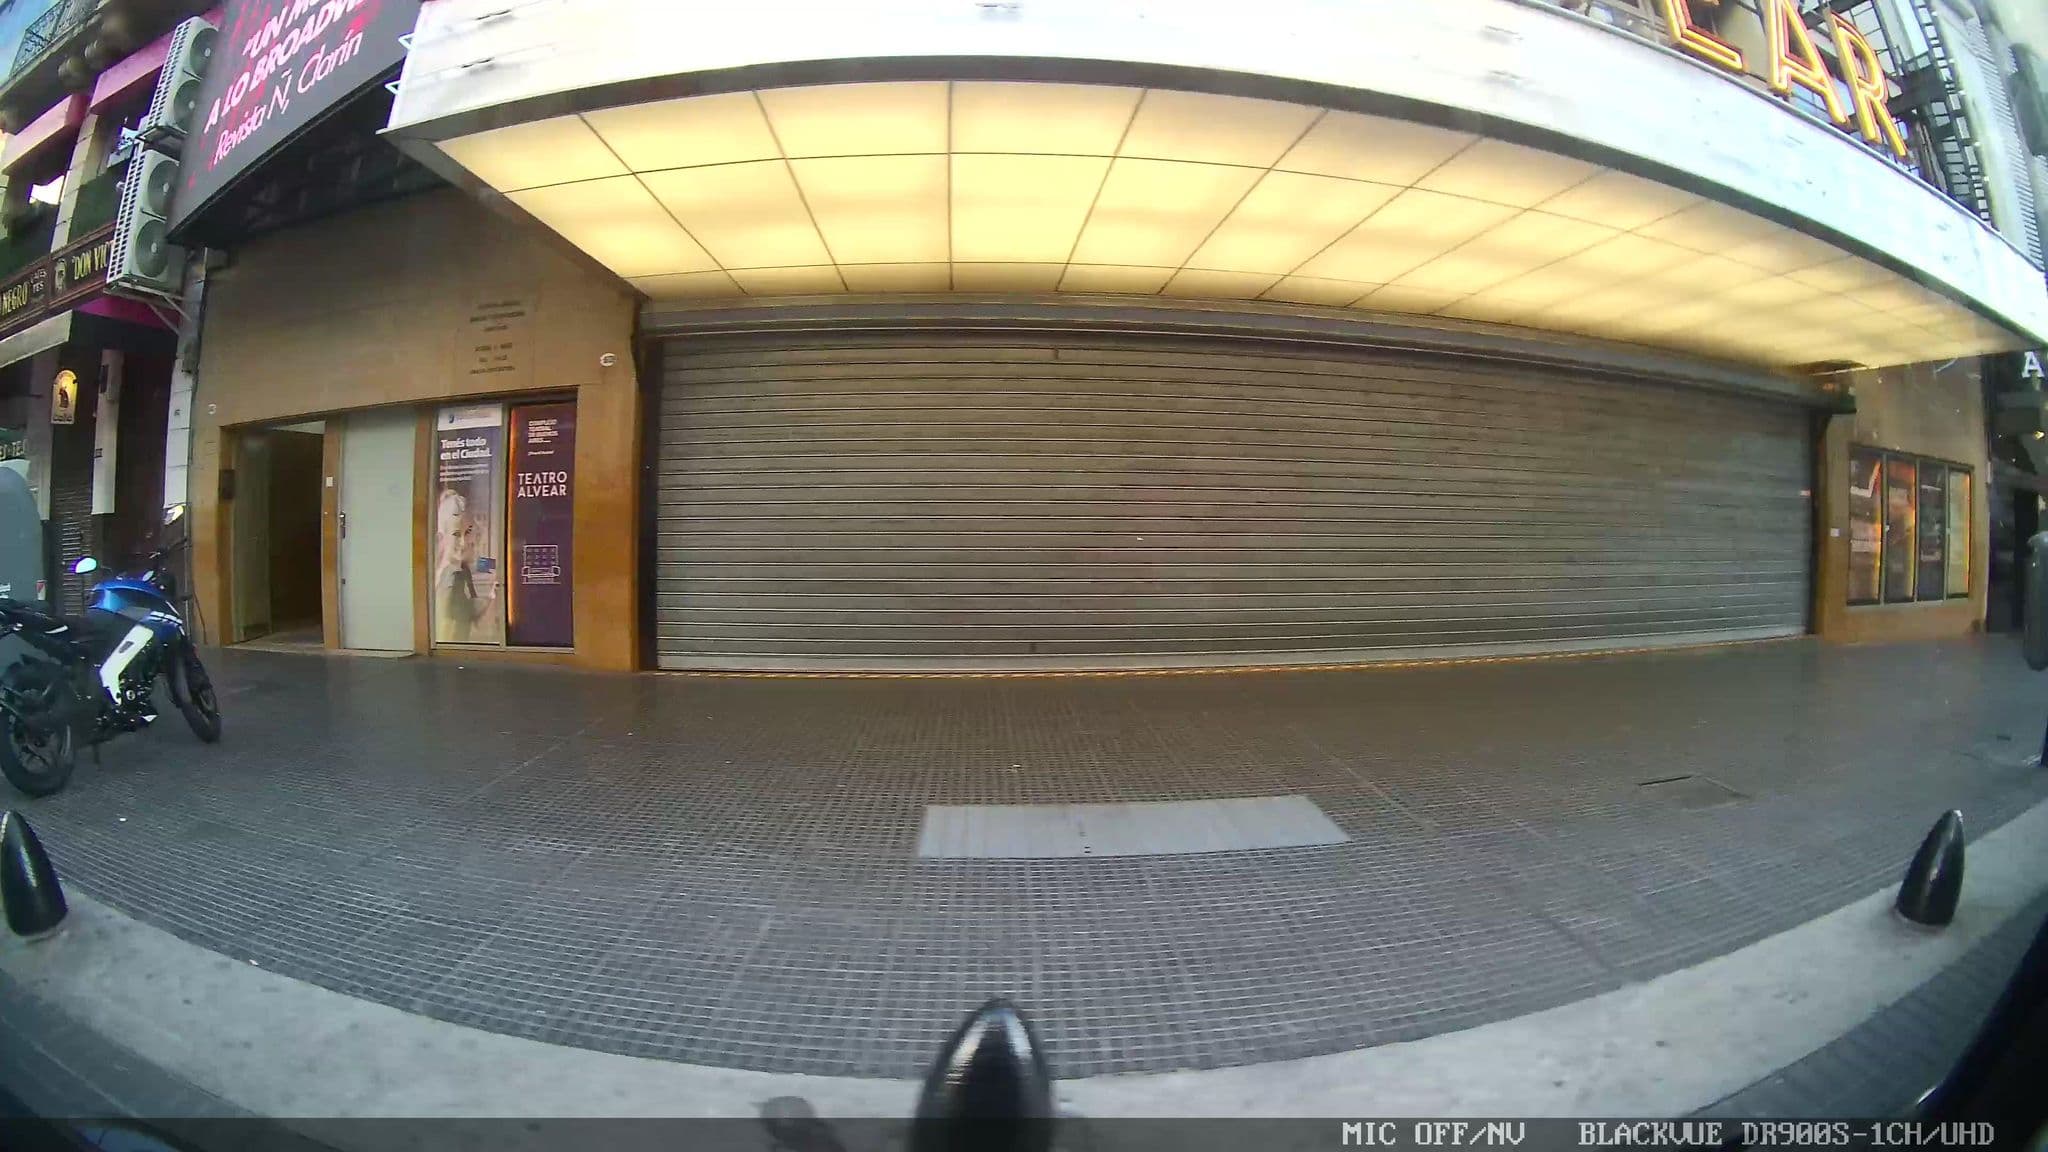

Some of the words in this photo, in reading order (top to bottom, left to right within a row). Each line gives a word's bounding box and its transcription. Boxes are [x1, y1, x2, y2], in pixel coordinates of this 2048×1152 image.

[204, 97, 221, 134] A
[221, 71, 251, 117] LO
[213, 104, 267, 165] Revista
[297, 29, 362, 93] Clarín
[517, 471, 568, 485] TEATRO
[517, 484, 567, 498] ALVEAR
